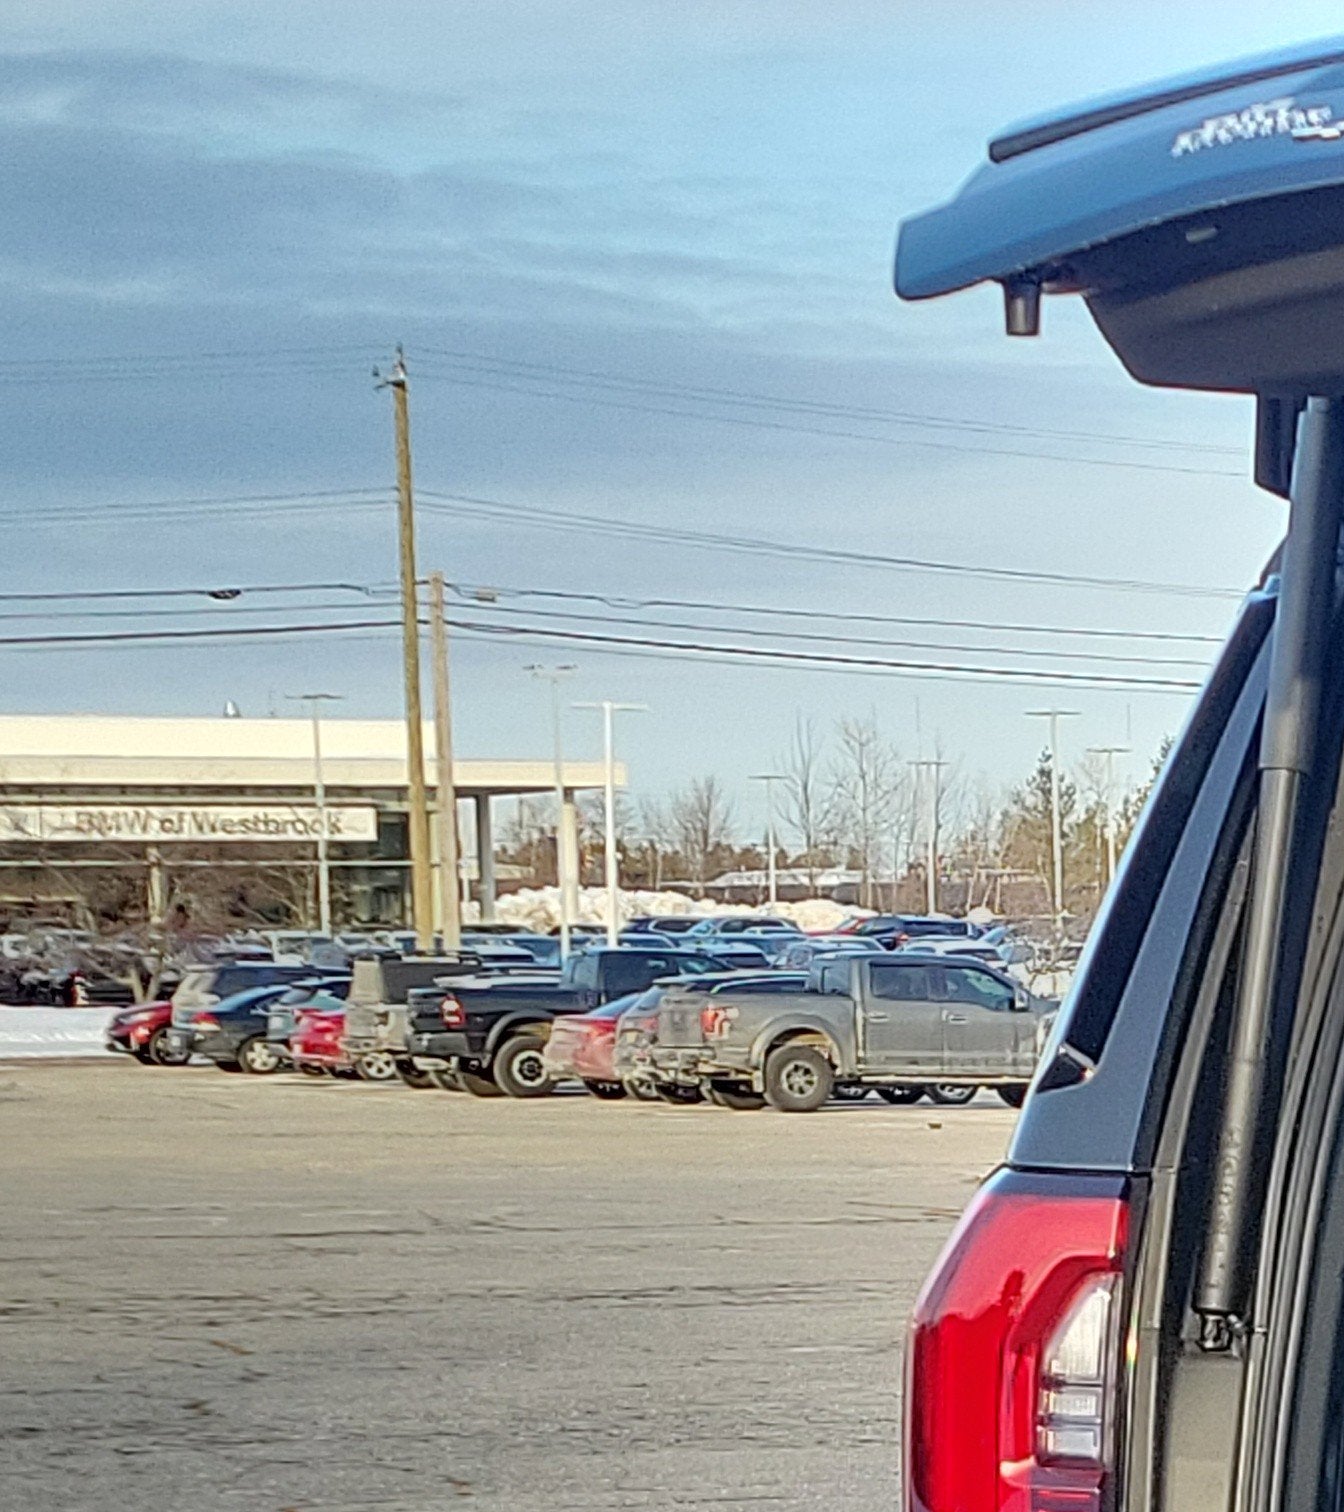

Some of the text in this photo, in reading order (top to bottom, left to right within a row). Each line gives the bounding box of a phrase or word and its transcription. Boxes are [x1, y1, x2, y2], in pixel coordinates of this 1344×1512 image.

[75, 811, 343, 835] BMW of Westbrook
